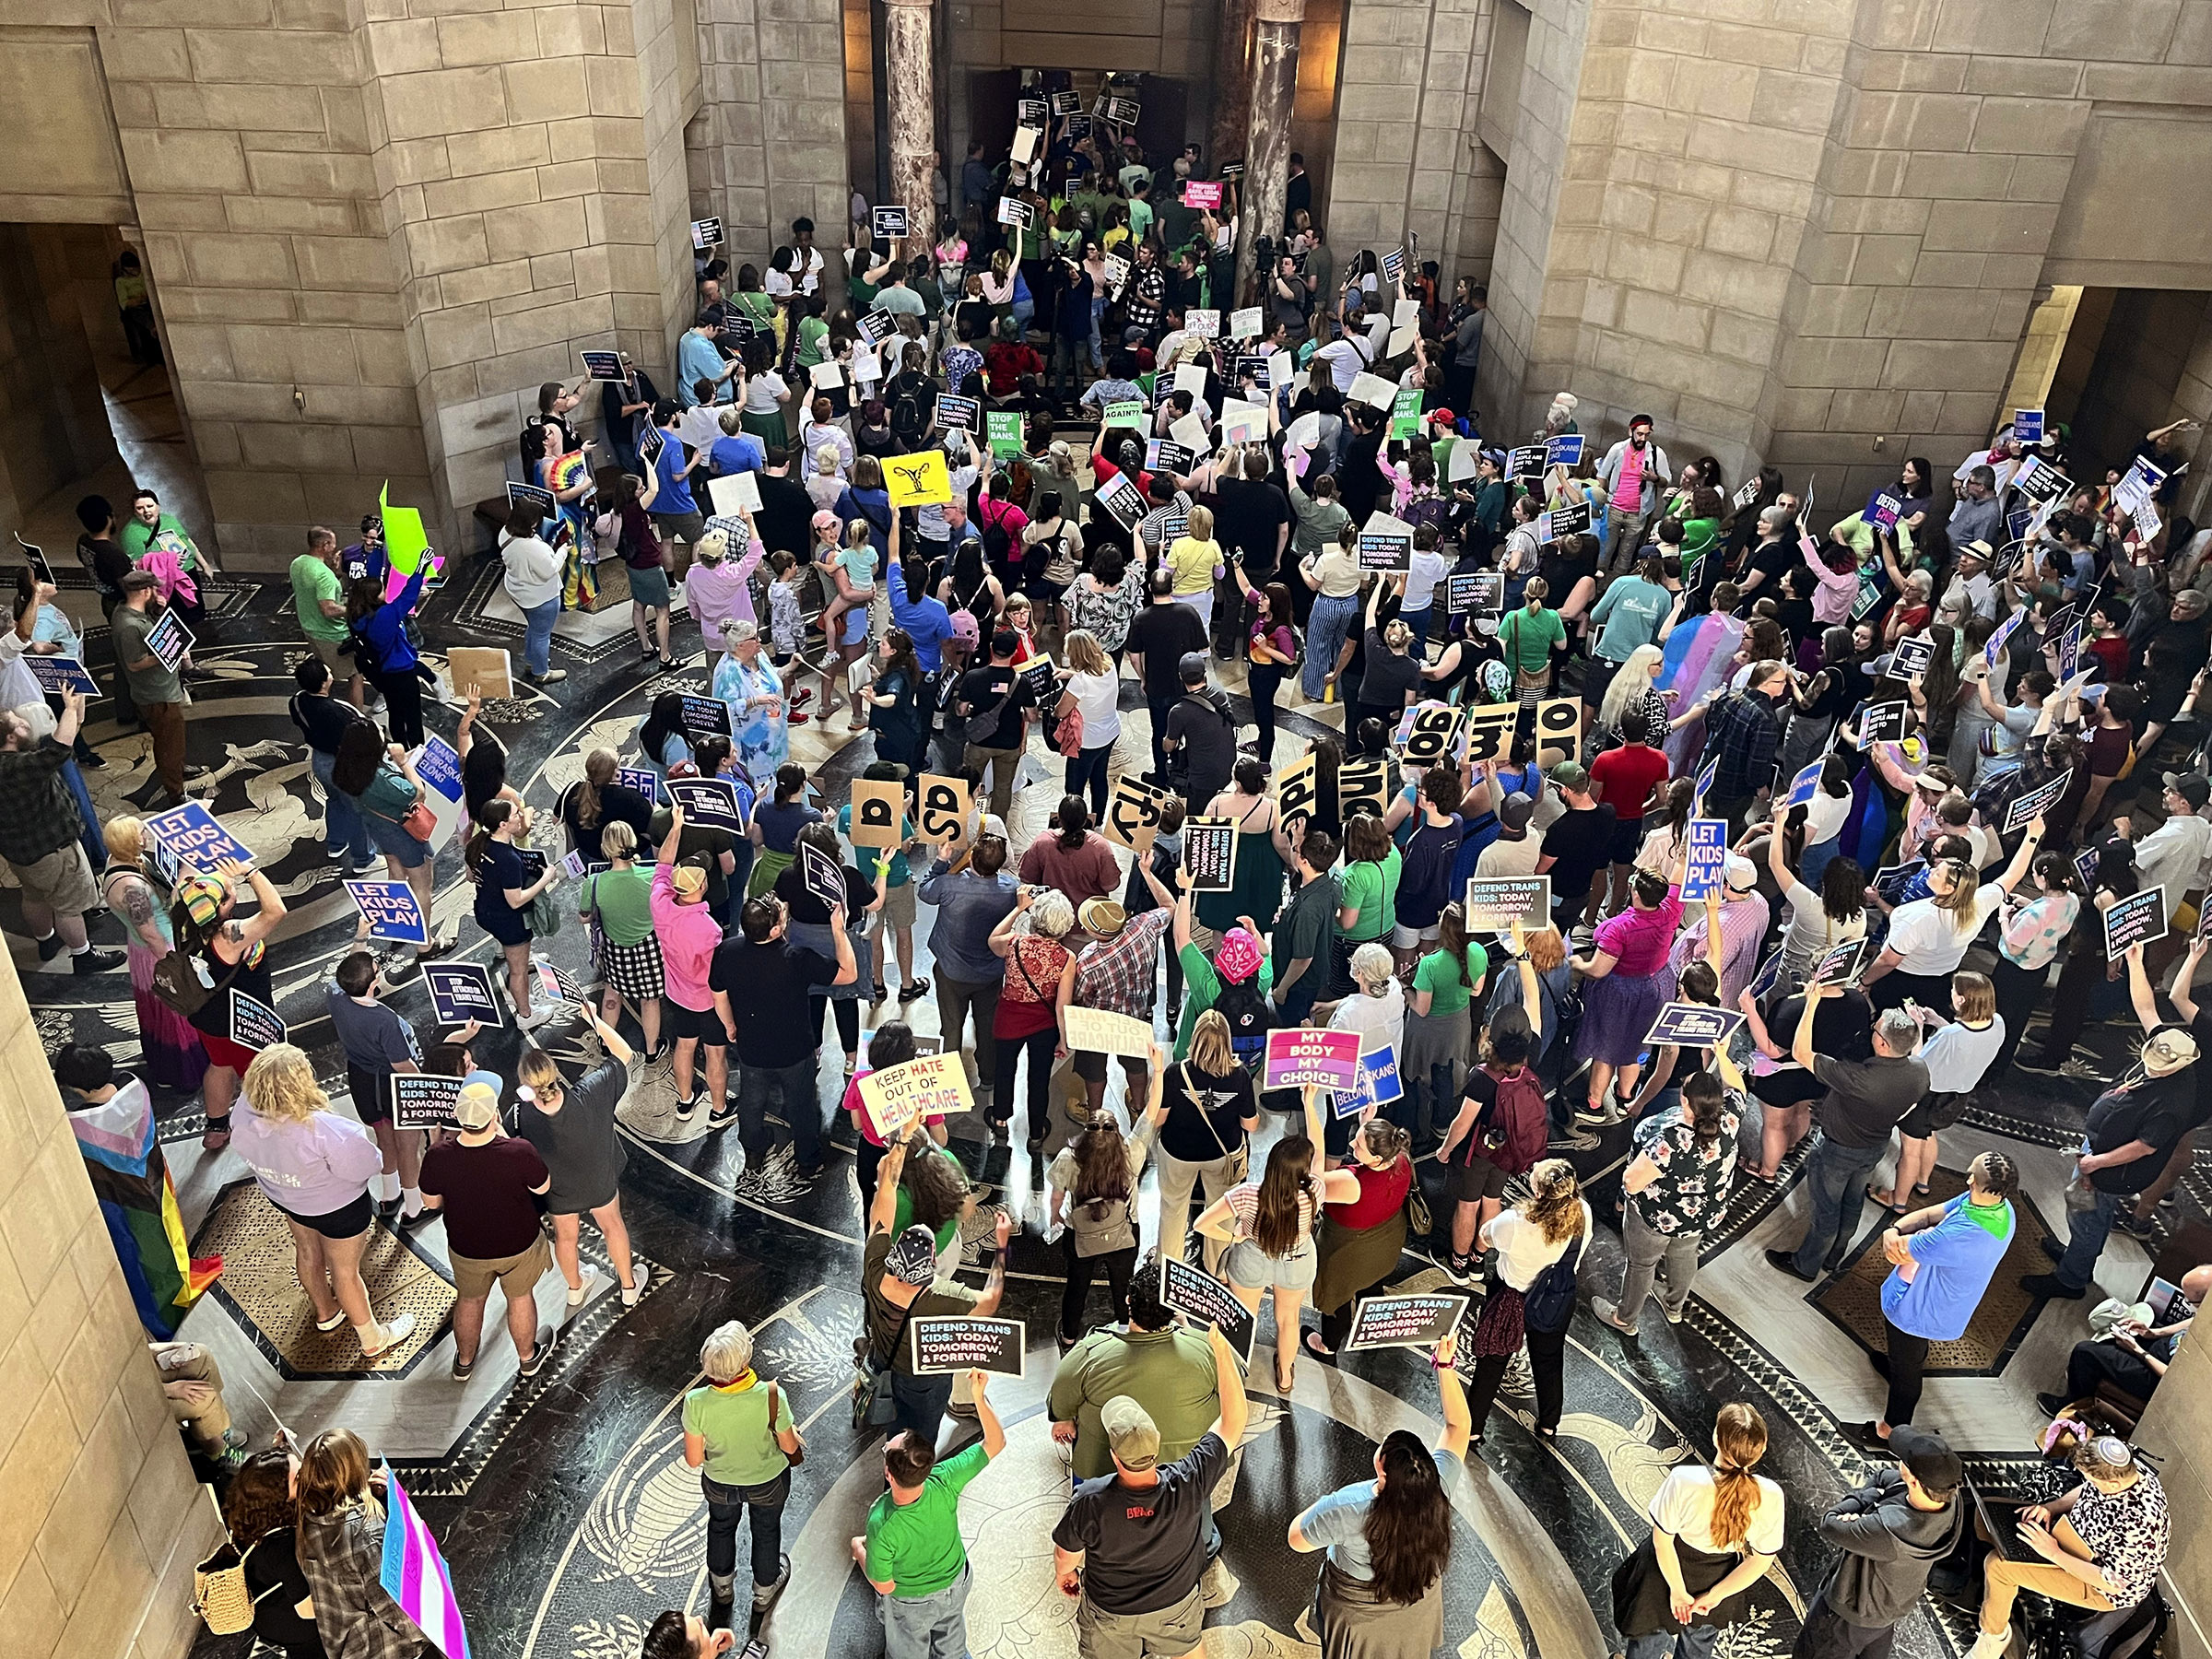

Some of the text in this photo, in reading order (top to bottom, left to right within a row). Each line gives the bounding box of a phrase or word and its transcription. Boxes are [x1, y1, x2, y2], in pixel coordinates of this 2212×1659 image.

[1233, 310, 1261, 320] ABORTION
[940, 397, 960, 406] DEFEND
[940, 410, 973, 421] TOMORROW,
[990, 415, 1013, 423] STOP
[1106, 410, 1139, 418] AGAIN??
[1394, 410, 1416, 418] BANS.
[990, 432, 1018, 441] BANS.
[1161, 448, 1191, 461] PEOPLE ARE
[1162, 443, 1180, 452] TRANS
[511, 485, 551, 500] DEFEND TRANS
[1124, 485, 1139, 502] TRANS
[1110, 497, 1123, 513] STAY.
[1115, 494, 1133, 514] HERE TO
[1119, 490, 1144, 517] PEOPLE ARE
[1453, 591, 1491, 599] TOMORROW,
[1027, 665, 1047, 677] TRANS
[1539, 704, 1577, 761] or
[429, 739, 455, 763] TRANS
[418, 759, 446, 783] ELONG
[923, 785, 961, 842] as
[1112, 775, 1164, 846] ify
[153, 813, 192, 837] LET
[168, 824, 219, 853] KIDS
[1692, 826, 1716, 843] LET
[182, 838, 236, 868] PLAY
[1191, 837, 1200, 870] FOREVER.
[1199, 830, 1211, 877] TOMORROW,
[1209, 830, 1220, 877] KIDS: TODAY,
[1218, 830, 1230, 884] DEFEND TRANS
[1690, 846, 1724, 865] KIDS
[1687, 865, 1724, 885] PLAY
[351, 885, 389, 896] LET
[1474, 882, 1541, 893] DEFEND TRANS
[358, 898, 413, 910] KIDS
[1473, 893, 1534, 903] KIDS: TODAY,
[1473, 903, 1534, 912] TOMORROW,
[2109, 893, 2159, 922] DEFEND TRANS
[365, 910, 418, 927] PLAY
[1481, 912, 1524, 922] FOREVER.
[2125, 907, 2153, 923] TODAY,
[2111, 915, 2153, 939] TOMORROW,
[2117, 926, 2147, 946] FOREVER.
[1834, 944, 1858, 957] TRANS
[236, 997, 264, 1015] DEFEND
[1301, 1033, 1326, 1043] MY
[1290, 1045, 1335, 1056] BODY
[1299, 1058, 1322, 1069] MY
[876, 1060, 945, 1088] KEEP HATE
[1279, 1072, 1340, 1086] CHOICE
[400, 1080, 462, 1091] DEFEND TRA
[885, 1077, 938, 1100] OUT OF
[400, 1090, 459, 1100] KIDS: TODA
[400, 1100, 458, 1110] TOMORRO
[879, 1089, 960, 1128] HEALTHCARE
[412, 1110, 459, 1120] FOREVER
[1170, 1273, 1239, 1324] KIDS: TODAY,
[1171, 1264, 1246, 1320] DEFEND TRANS
[1169, 1282, 1239, 1332] TOMORROW,
[1169, 1292, 1229, 1330] & FOREVER.
[1366, 1300, 1453, 1313] DEFEND TRANS
[1363, 1309, 1438, 1322] KIDS: TODAY,
[921, 1324, 1011, 1335] DEFEND TRANS
[1360, 1318, 1435, 1331] TOMORROW,
[922, 1334, 1003, 1346] KIDS: TODAY,
[1357, 1327, 1419, 1341] & FOREVER.
[921, 1344, 1003, 1356] TOMORROW,
[922, 1353, 991, 1363] & FOREVER.
